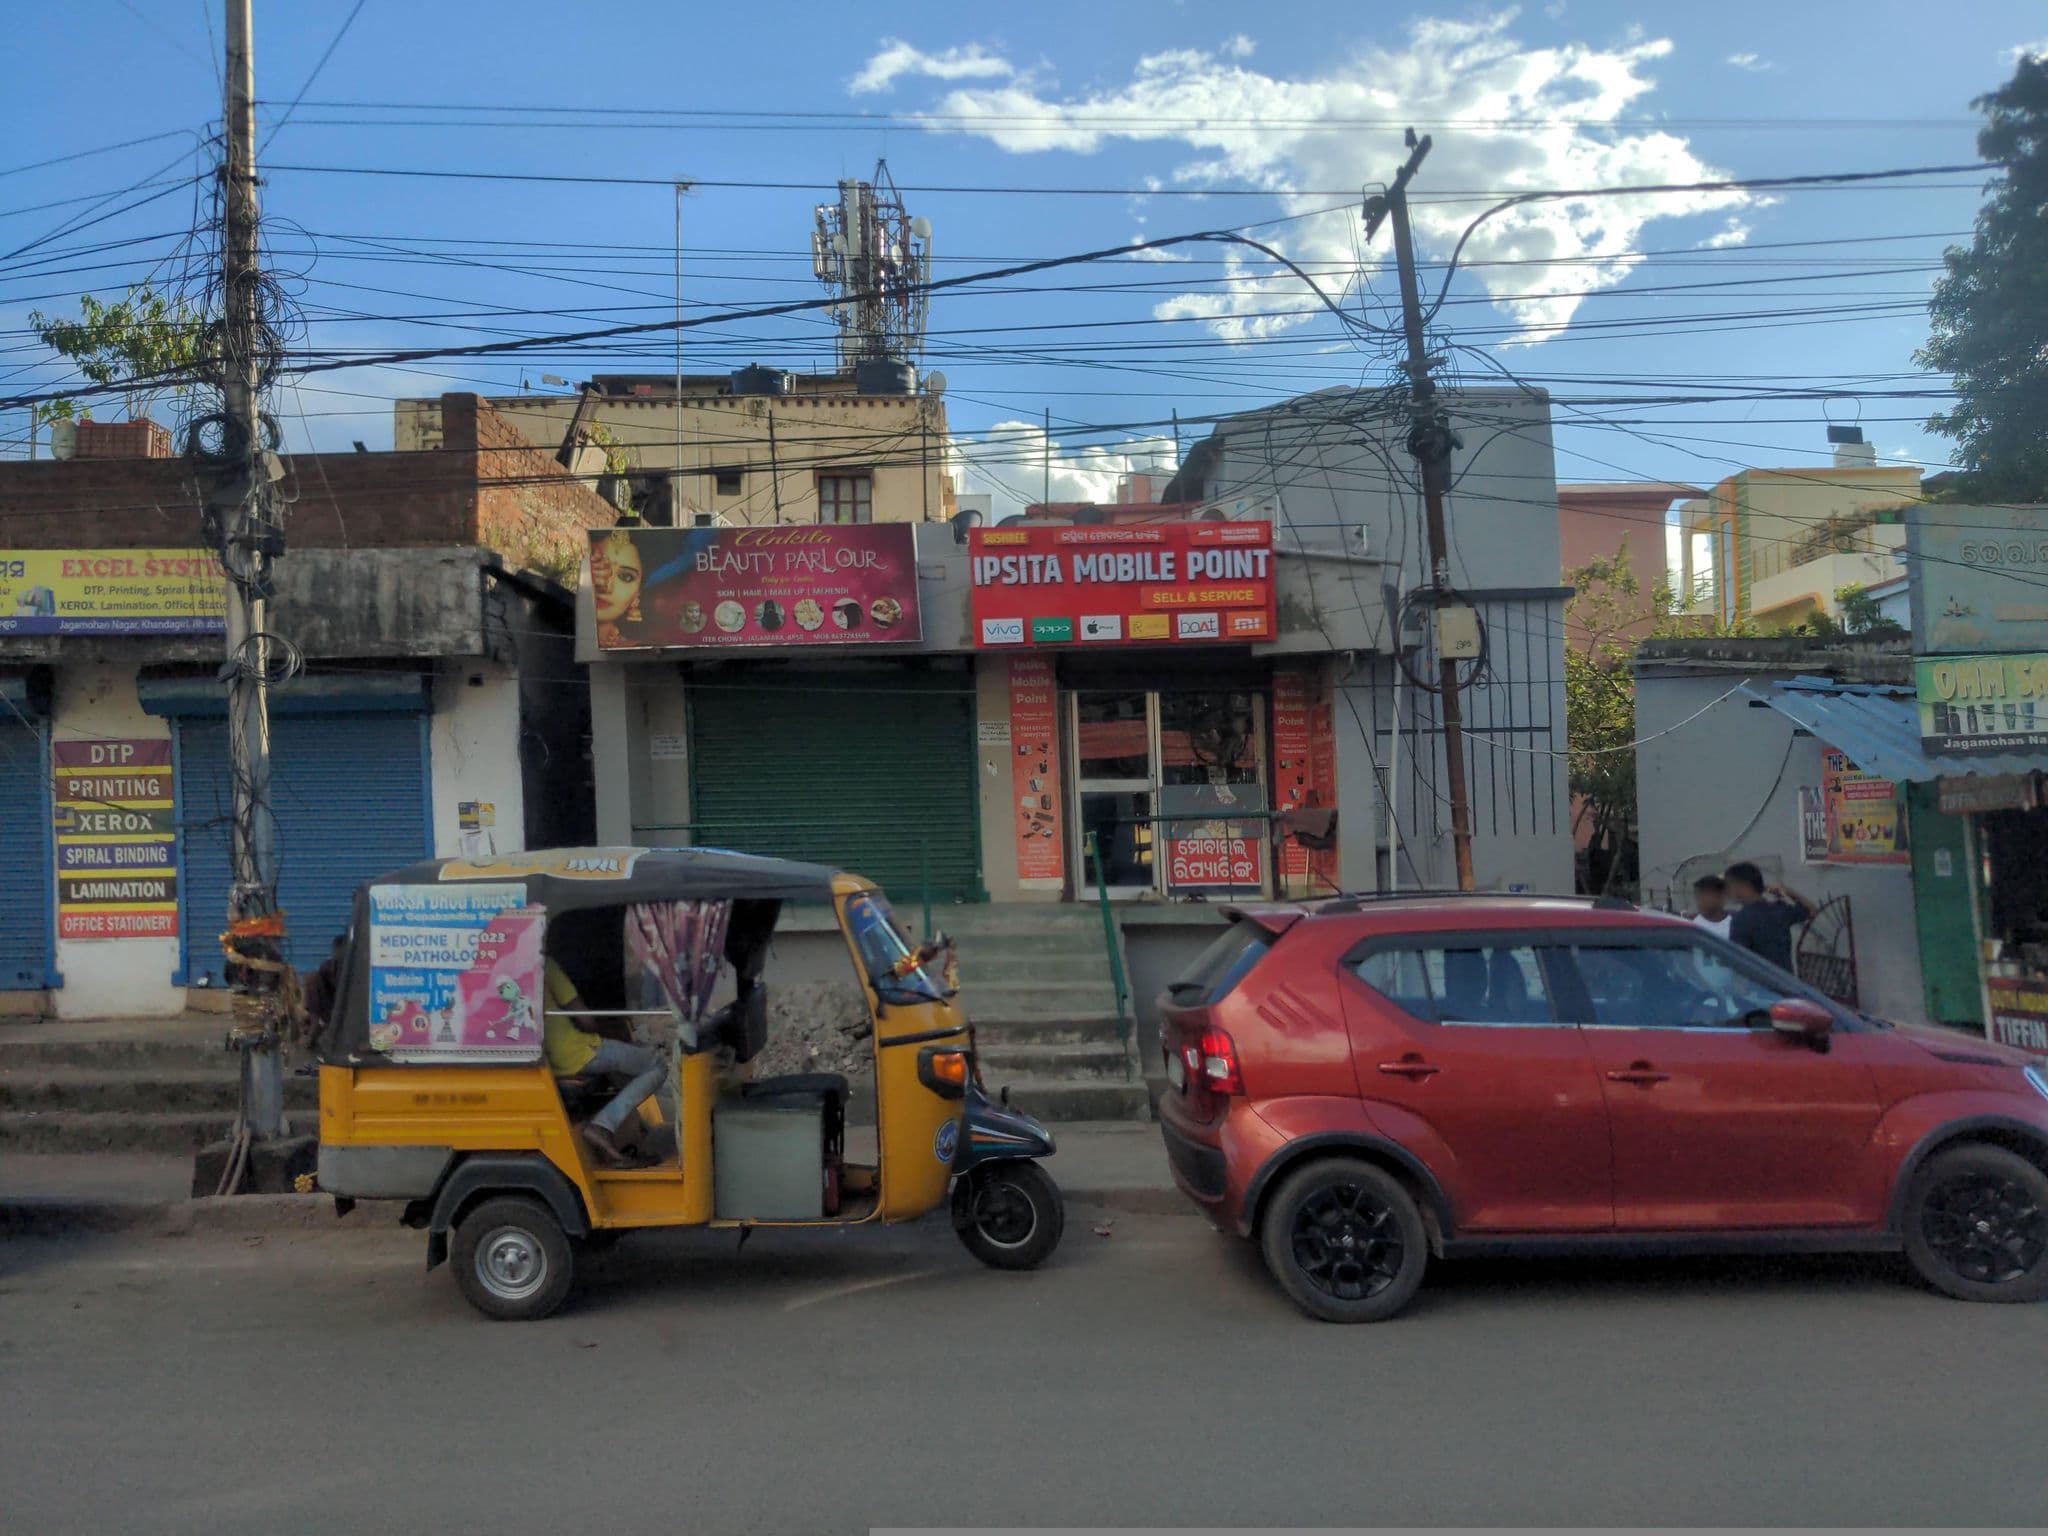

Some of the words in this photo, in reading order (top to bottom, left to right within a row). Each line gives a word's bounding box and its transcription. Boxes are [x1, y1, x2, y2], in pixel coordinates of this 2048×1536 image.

[62, 559, 138, 577] EXCEL
[695, 544, 776, 582] BEAUTY
[785, 548, 888, 574] PARLOUR
[974, 554, 1064, 586] IPSITA
[1073, 552, 1176, 584] MOBILE
[1187, 549, 1269, 581] POINT
[84, 585, 106, 596] DTP,
[109, 585, 151, 597] Printing,
[155, 585, 186, 597] Spiral
[1152, 592, 1185, 604] SELL
[1187, 591, 1197, 602] &
[1200, 590, 1254, 602] SERVICE
[164, 601, 193, 610] Office
[1012, 677, 1050, 688] Mobile
[1934, 662, 2006, 699] OMM
[1016, 693, 1048, 705] Point
[1278, 716, 1305, 727] Point
[1943, 737, 2024, 750] Jagamohan
[91, 744, 134, 763] DTP
[69, 778, 160, 797] PRINTING
[80, 812, 153, 831] XEROX
[66, 848, 110, 865] SPIRAL
[115, 847, 167, 864] BINDING
[71, 882, 165, 899] LAMINATION
[64, 917, 104, 932] OFFICE
[107, 914, 172, 931] STATIONERY
[380, 934, 448, 948] MEDICINE
